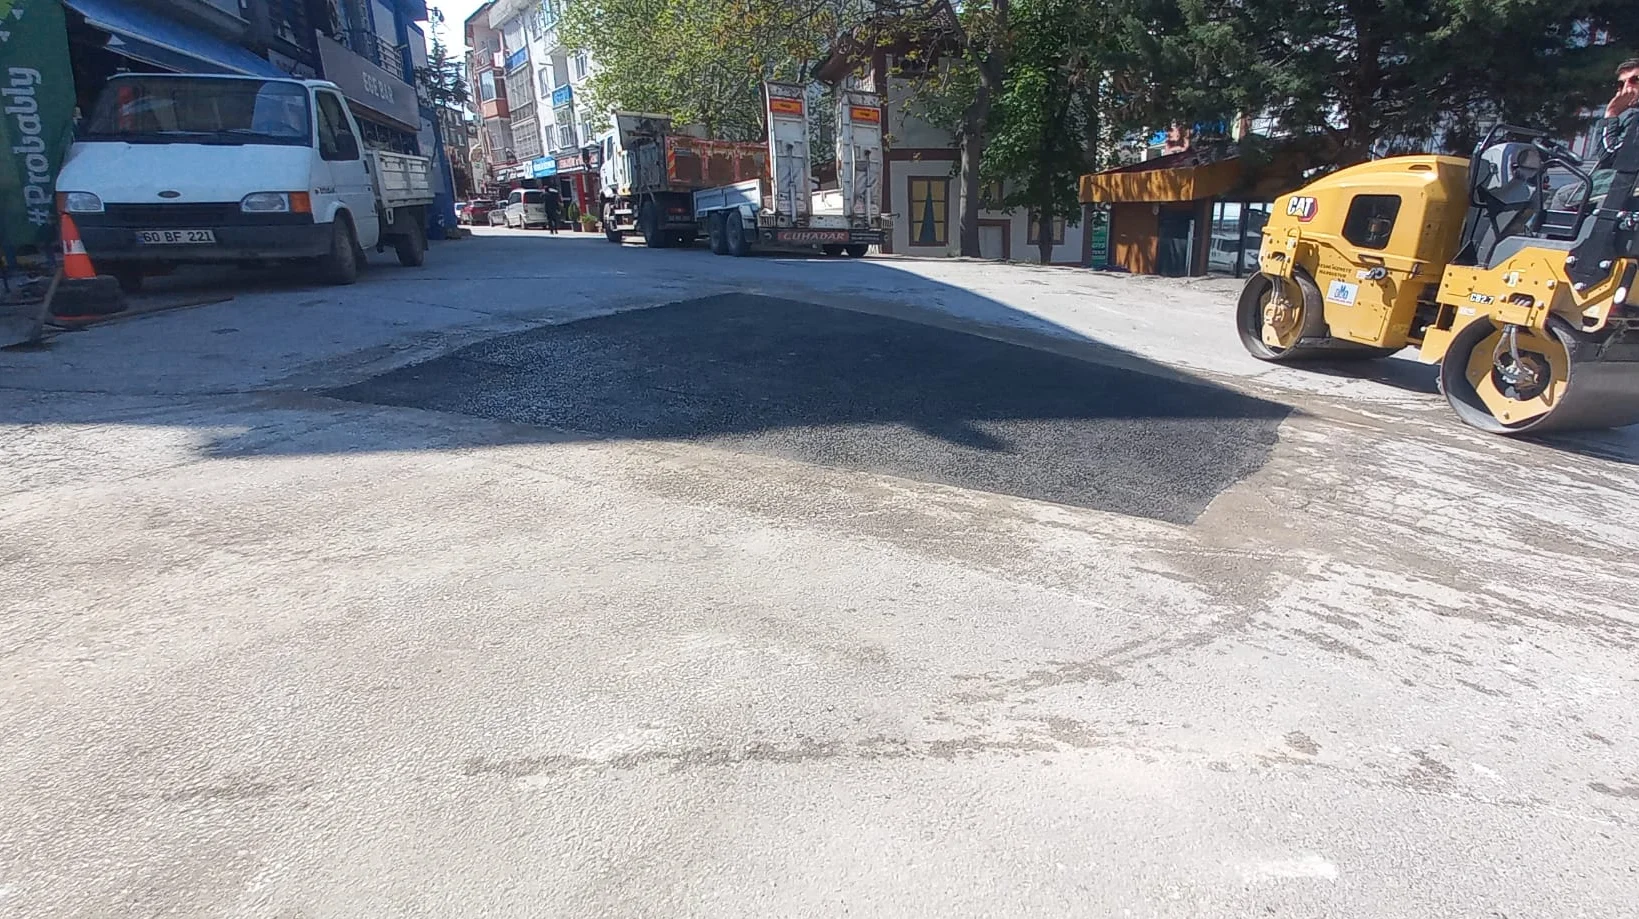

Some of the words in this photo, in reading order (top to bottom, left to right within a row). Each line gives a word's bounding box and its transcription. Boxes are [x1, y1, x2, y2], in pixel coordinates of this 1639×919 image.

[2, 67, 53, 226] #Probably
[1287, 196, 1314, 216] CAT
[143, 231, 161, 243] 60
[164, 231, 182, 243] BF
[187, 231, 213, 242] 221
